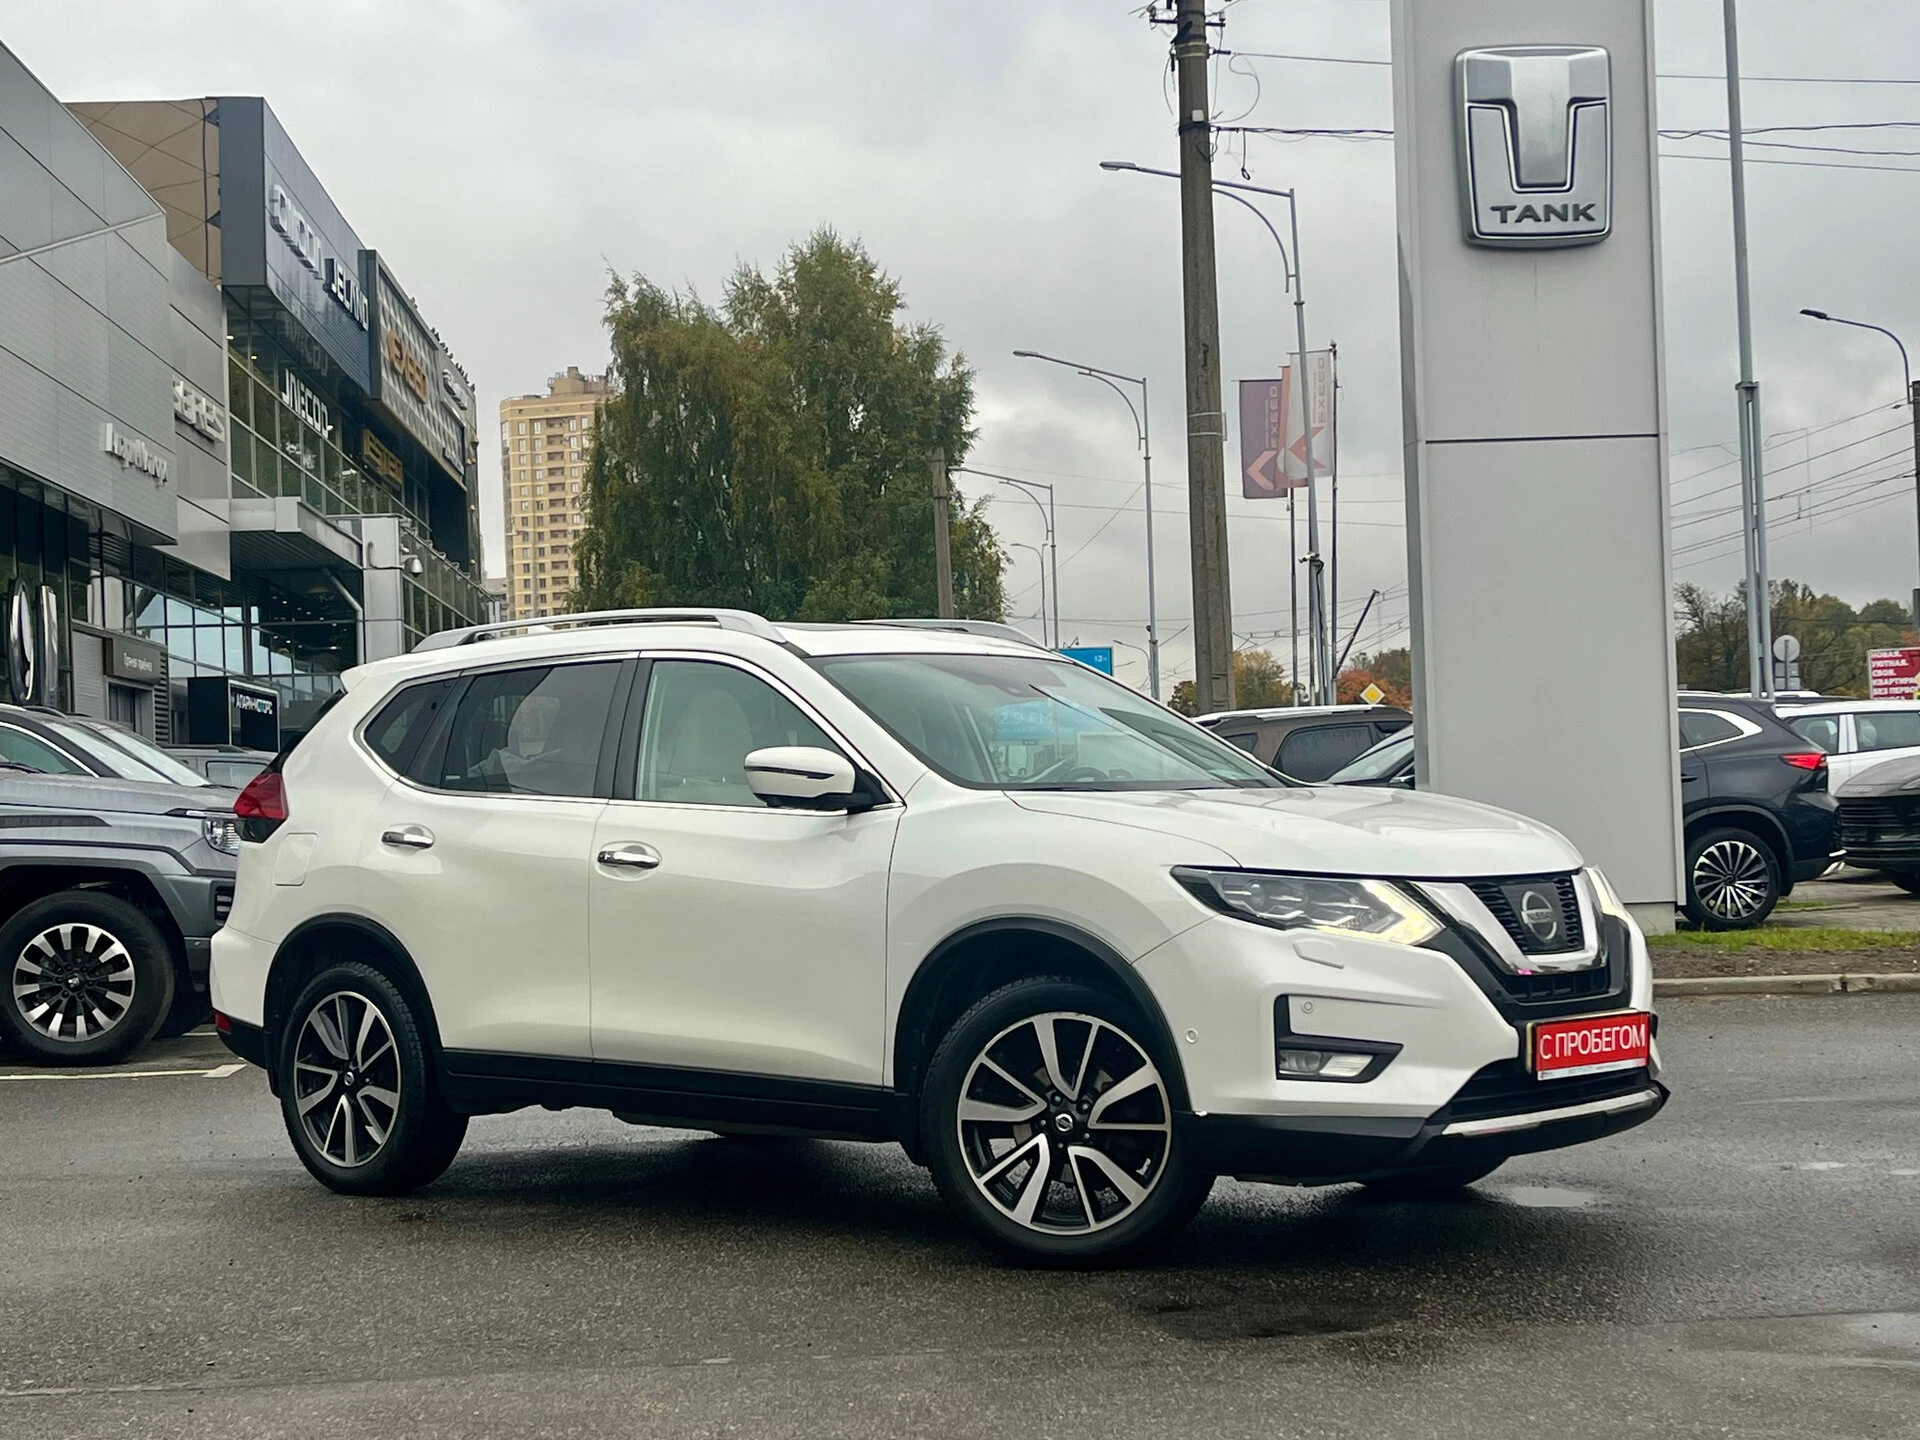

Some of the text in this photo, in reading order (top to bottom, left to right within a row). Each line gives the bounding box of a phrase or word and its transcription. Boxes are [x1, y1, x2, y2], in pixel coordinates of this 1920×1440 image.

[1489, 203, 1596, 224] TANK
[1539, 1023, 1646, 1060] С ПРОБЕГОМ
